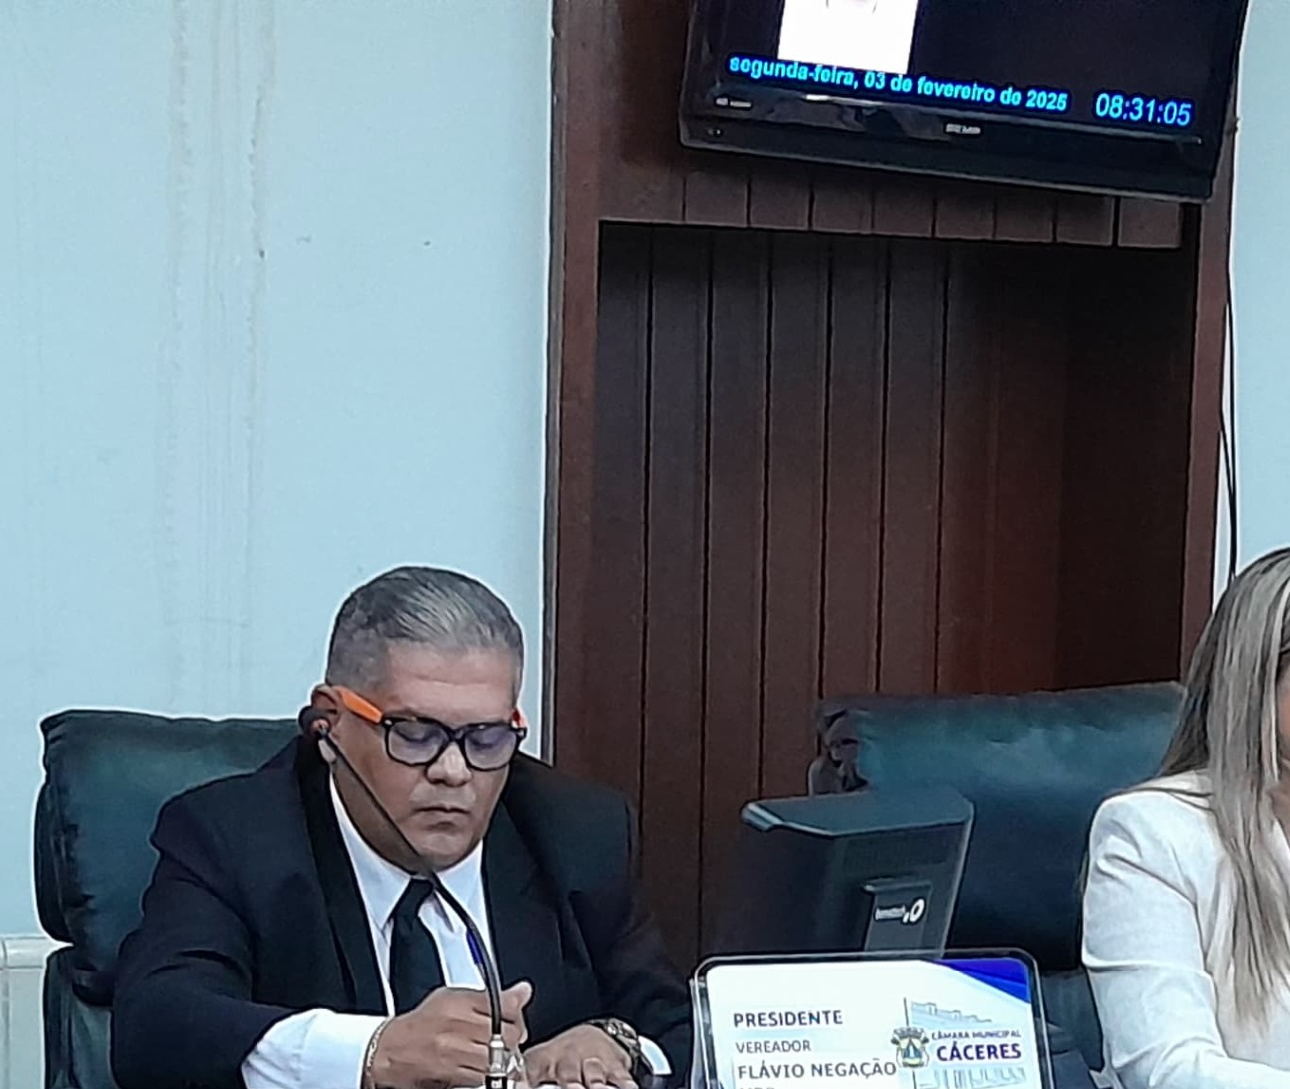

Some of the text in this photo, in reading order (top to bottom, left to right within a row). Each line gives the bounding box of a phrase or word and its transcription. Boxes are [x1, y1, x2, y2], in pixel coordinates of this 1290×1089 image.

[864, 71, 885, 89] 03
[890, 74, 912, 92] de
[917, 76, 995, 102] fevereiro
[1000, 86, 1022, 105] de
[1095, 92, 1192, 126] 08:31:05
[733, 1010, 843, 1028] PRESIDENTE
[972, 1029, 1022, 1039] MUNICIPAL
[735, 1039, 812, 1054] VEREADOR
[936, 1040, 1022, 1061] CÁCERES
[738, 1057, 897, 1080] FLÁVIO NEGAÇÃO
